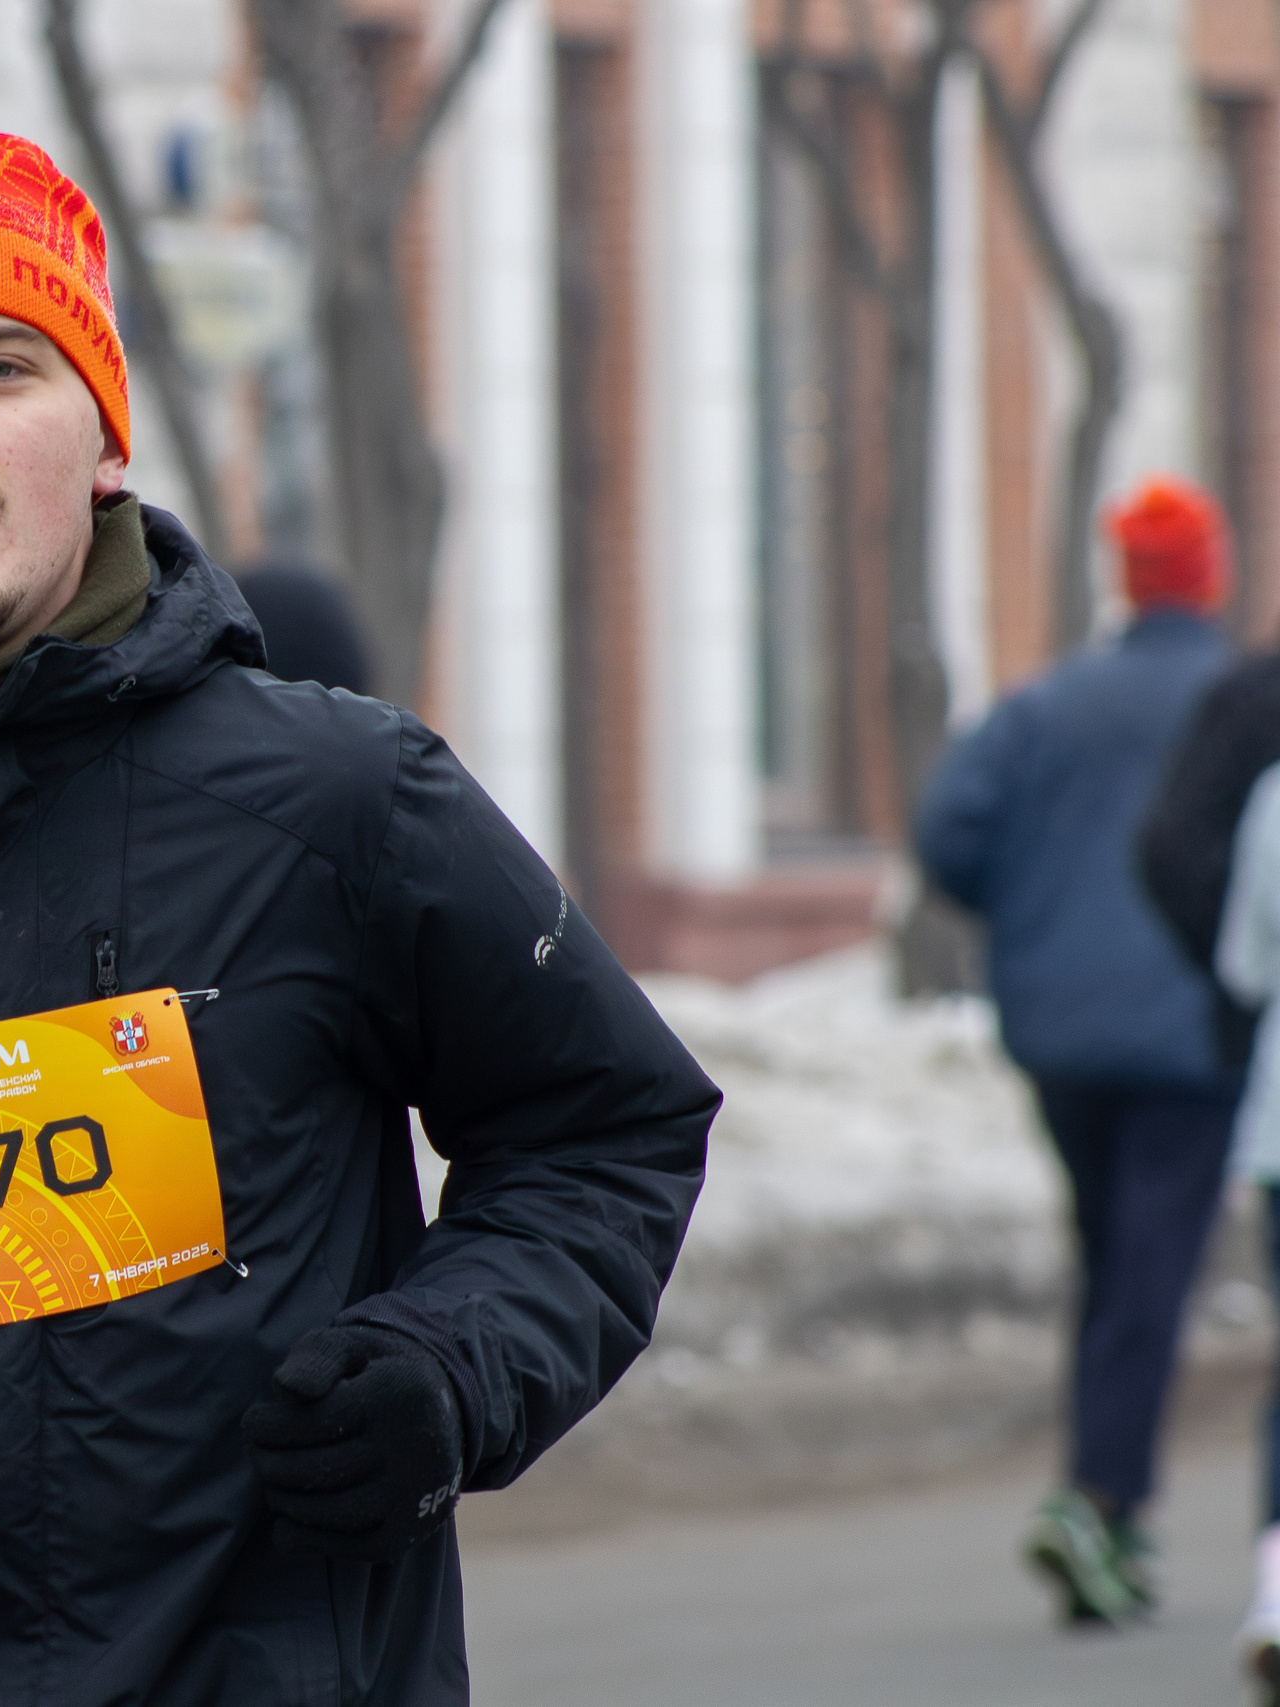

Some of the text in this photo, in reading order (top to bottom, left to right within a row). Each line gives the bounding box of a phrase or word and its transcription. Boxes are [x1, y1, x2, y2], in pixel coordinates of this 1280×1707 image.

[88, 1242, 210, 1287] 7 ЯНВАРЯ 2025
